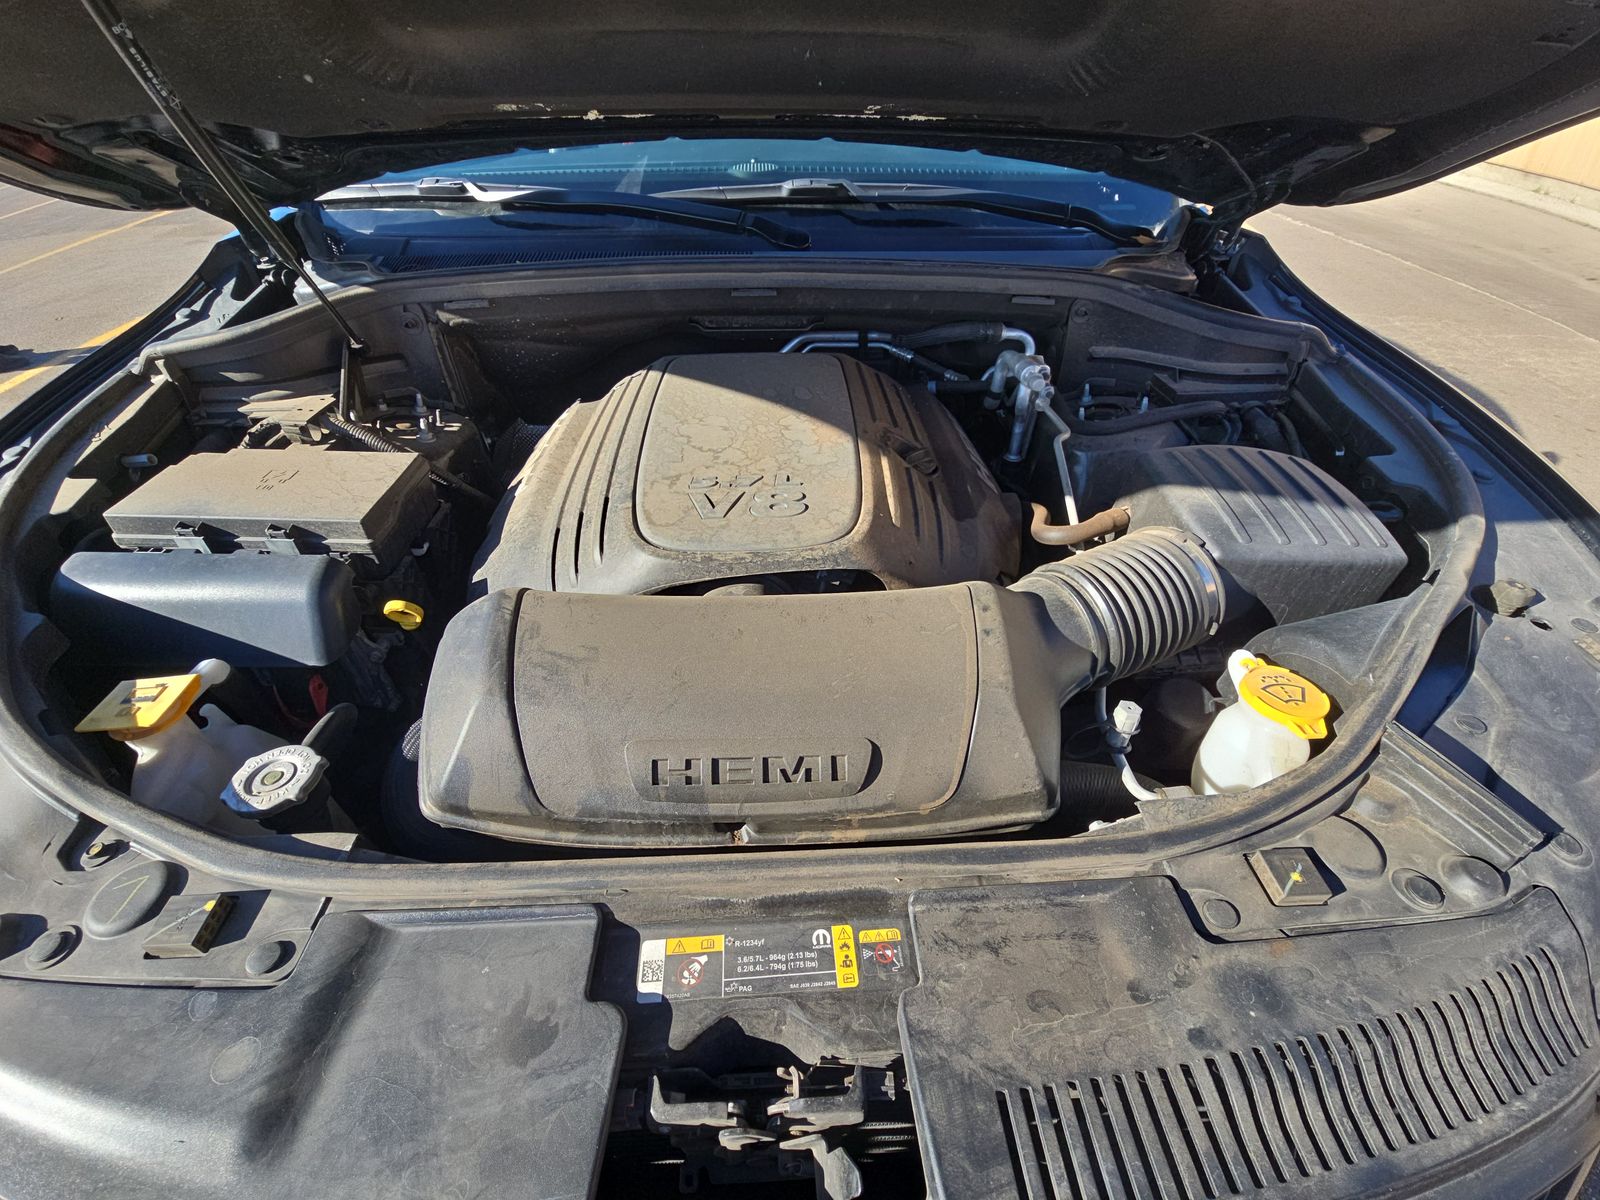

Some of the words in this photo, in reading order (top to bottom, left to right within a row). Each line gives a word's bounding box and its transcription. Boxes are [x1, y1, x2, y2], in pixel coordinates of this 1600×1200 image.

[129, 47, 168, 97] STABILUS
[688, 491, 810, 519] V8
[651, 753, 850, 787] HEMI
[734, 938, 765, 948] R-1234yf
[737, 955, 764, 964] 3.6/5.7L
[769, 963, 787, 971] 794g
